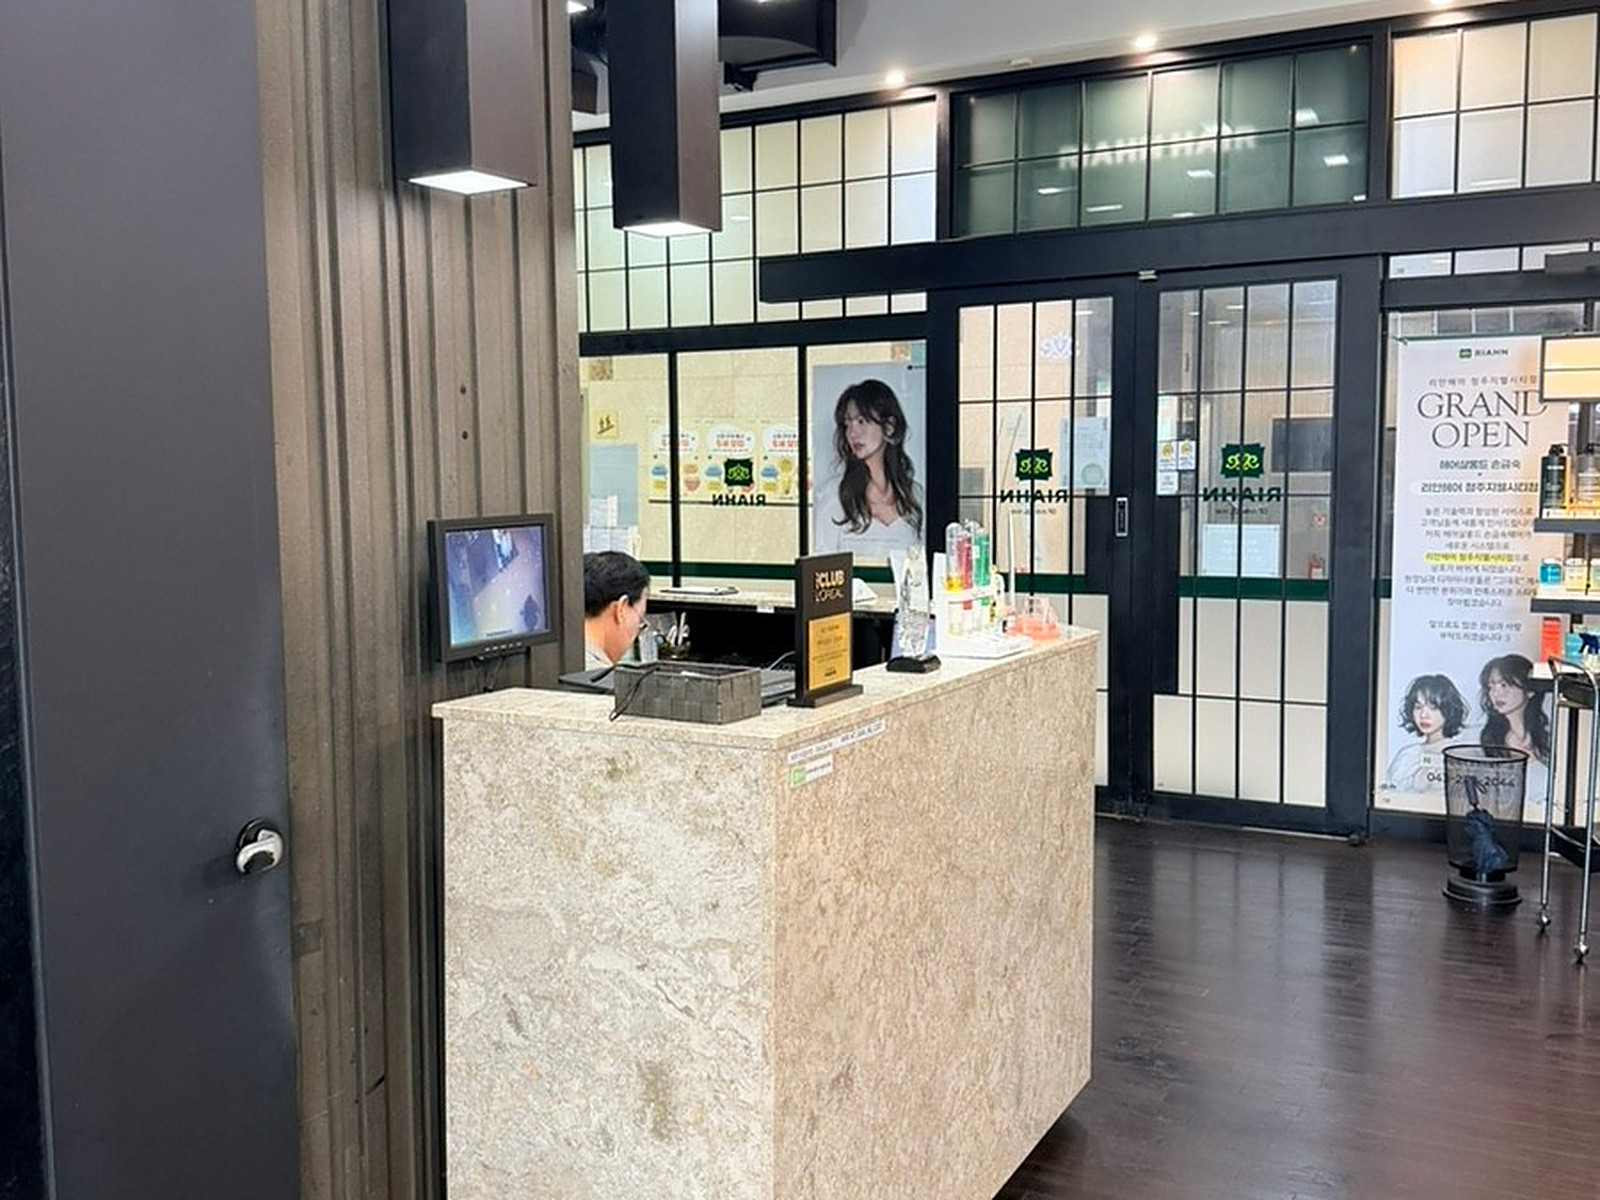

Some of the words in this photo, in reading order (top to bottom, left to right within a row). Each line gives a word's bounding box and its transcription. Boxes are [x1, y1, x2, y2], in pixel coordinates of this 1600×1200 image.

[1475, 348, 1509, 356] RIAHN
[1417, 390, 1548, 419] GRAND
[1432, 421, 1531, 448] OPEN
[1421, 482, 1463, 493] 리안헤어
[820, 569, 845, 588] CLUB
